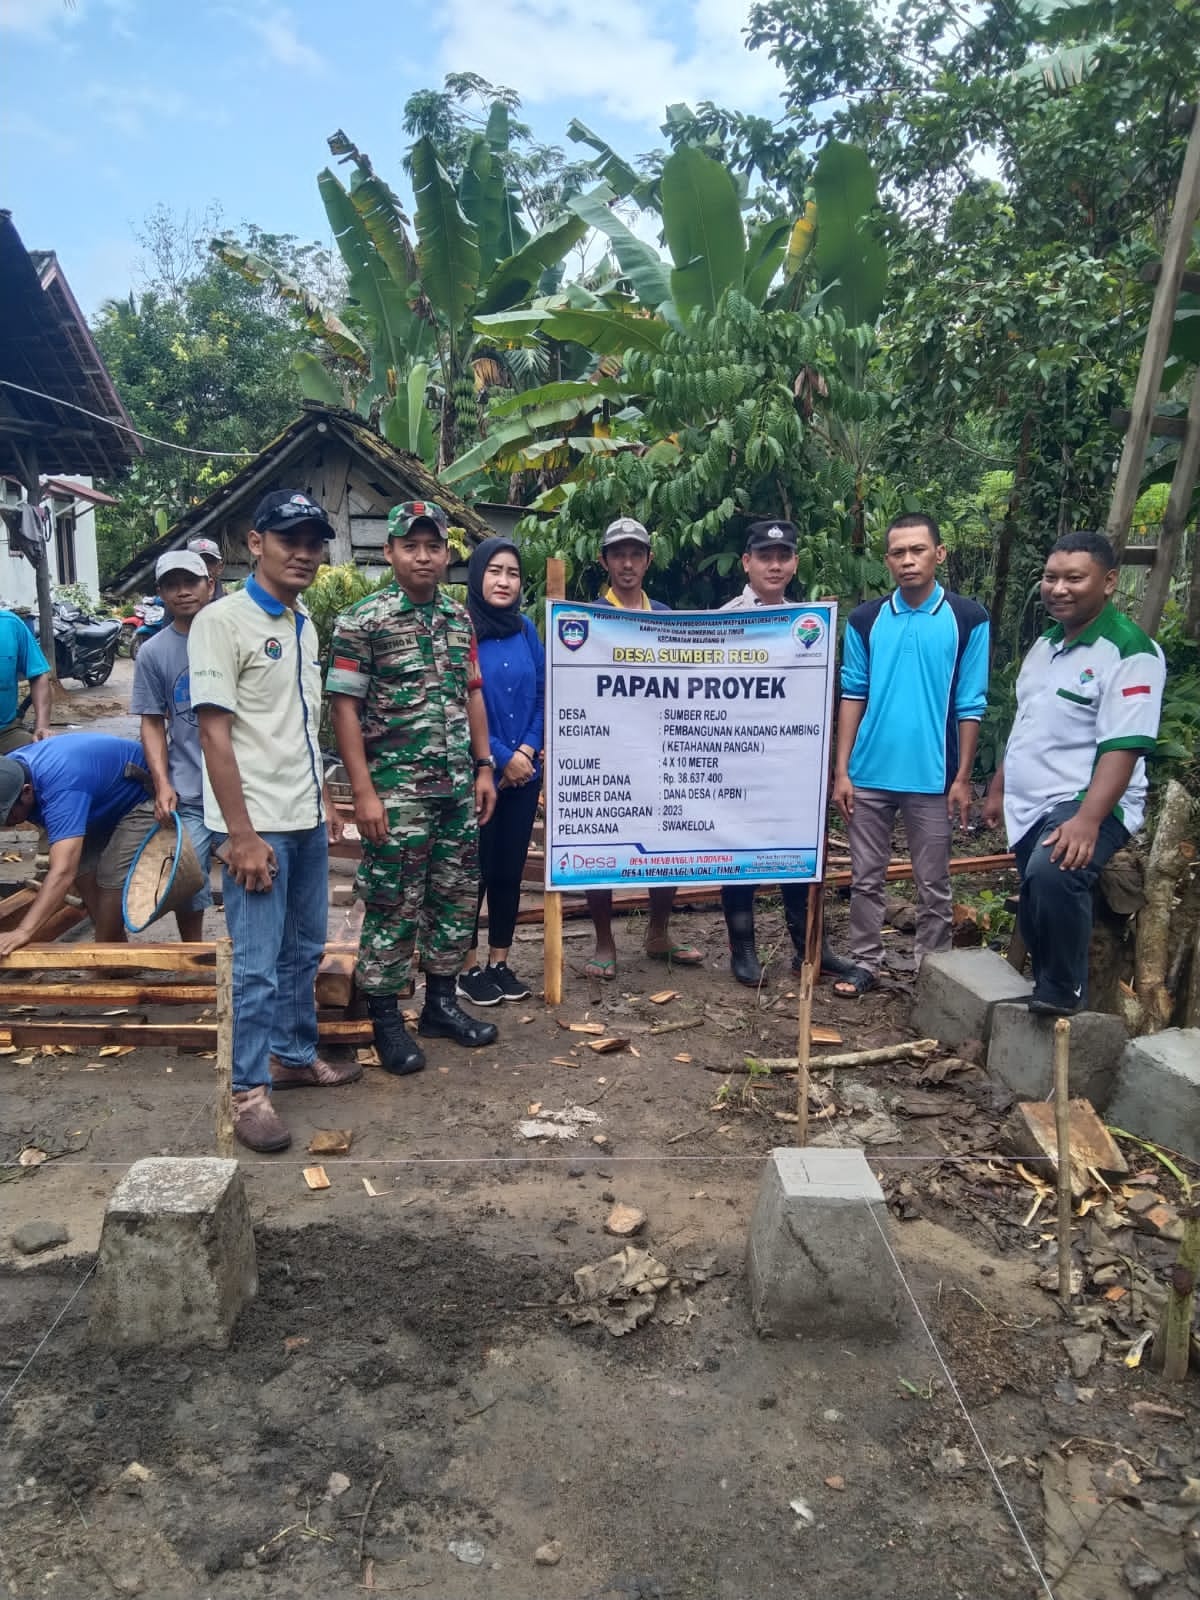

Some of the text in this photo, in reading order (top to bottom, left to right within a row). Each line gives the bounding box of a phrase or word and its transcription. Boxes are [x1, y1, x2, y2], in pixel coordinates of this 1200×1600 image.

[728, 628, 744, 636] TIMUR
[658, 635, 691, 643] KECAMATAN
[612, 647, 769, 664] DESA SUMBER REJO
[596, 674, 786, 699] PAPAN PROYEK
[559, 708, 586, 720] DESA
[664, 709, 702, 720] SUMBER
[704, 710, 727, 721] REJO
[559, 725, 610, 736] KEGIATAN
[664, 725, 732, 736] PEMBANGUNAN
[734, 725, 778, 736] KANDANG
[779, 724, 820, 736] KAMBING
[667, 741, 721, 752] KETAHANAN
[724, 742, 760, 753] PANGAN
[558, 758, 601, 770] VOLUME
[662, 757, 668, 767] 4
[669, 758, 675, 767] X
[677, 757, 687, 767] 10
[689, 757, 719, 768] METER
[558, 775, 600, 786] JUMLAH
[602, 774, 631, 785] DANA
[558, 791, 601, 802] SUMBER
[603, 791, 632, 801] DANA
[664, 789, 686, 800] DANA
[688, 788, 711, 799] DESA
[718, 788, 742, 799] APBN
[559, 807, 593, 818] TAHUN
[595, 806, 653, 818] ANGGARAN
[663, 805, 683, 816] 2023
[558, 823, 619, 835] PELAKSANA
[662, 820, 715, 832] SWAKELOLA
[573, 854, 617, 869] Desa
[630, 857, 648, 866] DESA
[621, 868, 642, 878] DESA
[716, 865, 741, 876] TIMUR
